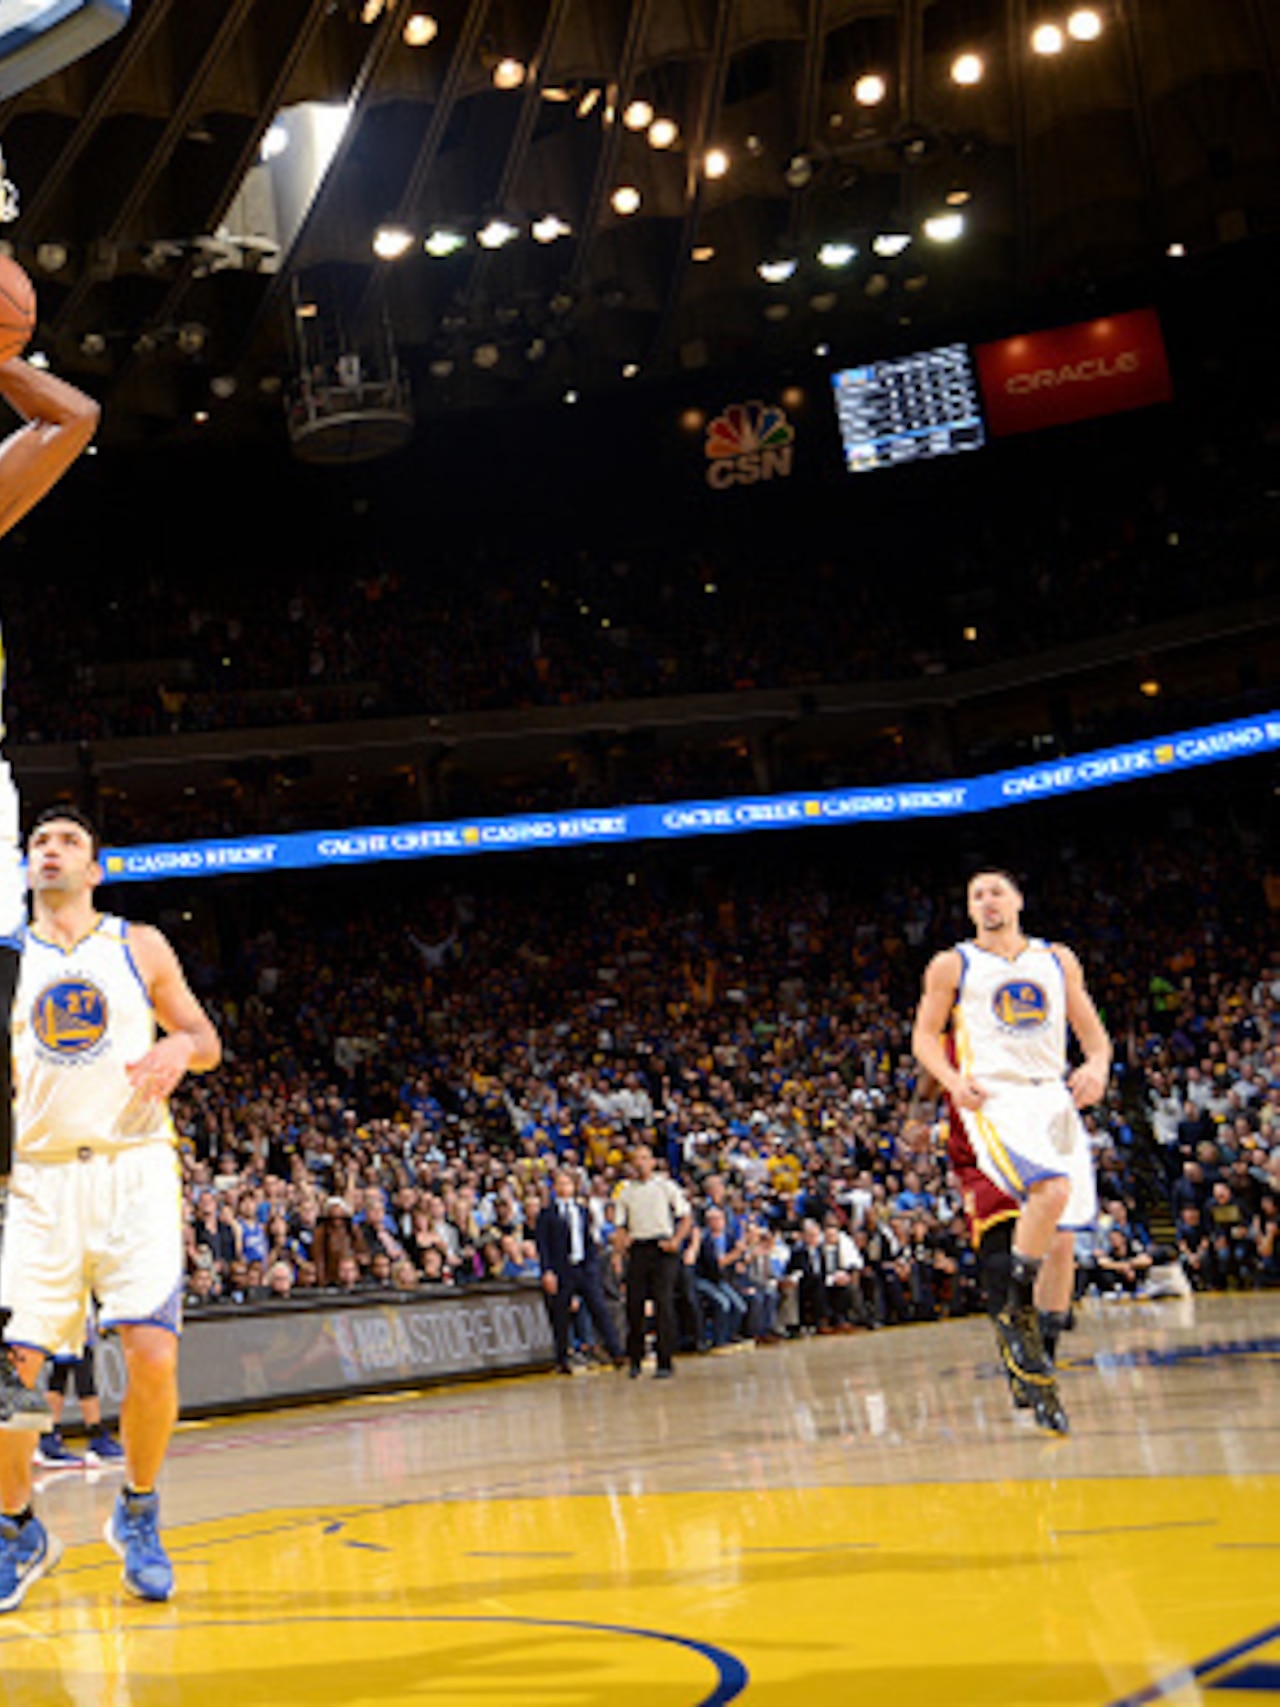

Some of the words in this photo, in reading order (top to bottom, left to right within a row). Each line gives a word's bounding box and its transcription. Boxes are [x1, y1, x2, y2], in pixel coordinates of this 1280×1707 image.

[1006, 351, 1139, 395] ORACLE
[705, 446, 793, 490] CSN
[1002, 765, 1075, 796] CACHE
[1077, 749, 1153, 781] CREEK
[1176, 726, 1265, 761] CASINO
[663, 807, 734, 830] CACHE
[735, 800, 802, 824] CREEK
[822, 794, 895, 817] CASINO
[898, 787, 967, 811] RESORT
[317, 834, 388, 856] CACHE
[391, 829, 462, 853] CREEK
[481, 820, 556, 843] CASINO
[558, 815, 627, 838] RESORT
[126, 851, 204, 873] CASINO
[206, 843, 277, 866] RESORT
[66, 990, 97, 1014] 27
